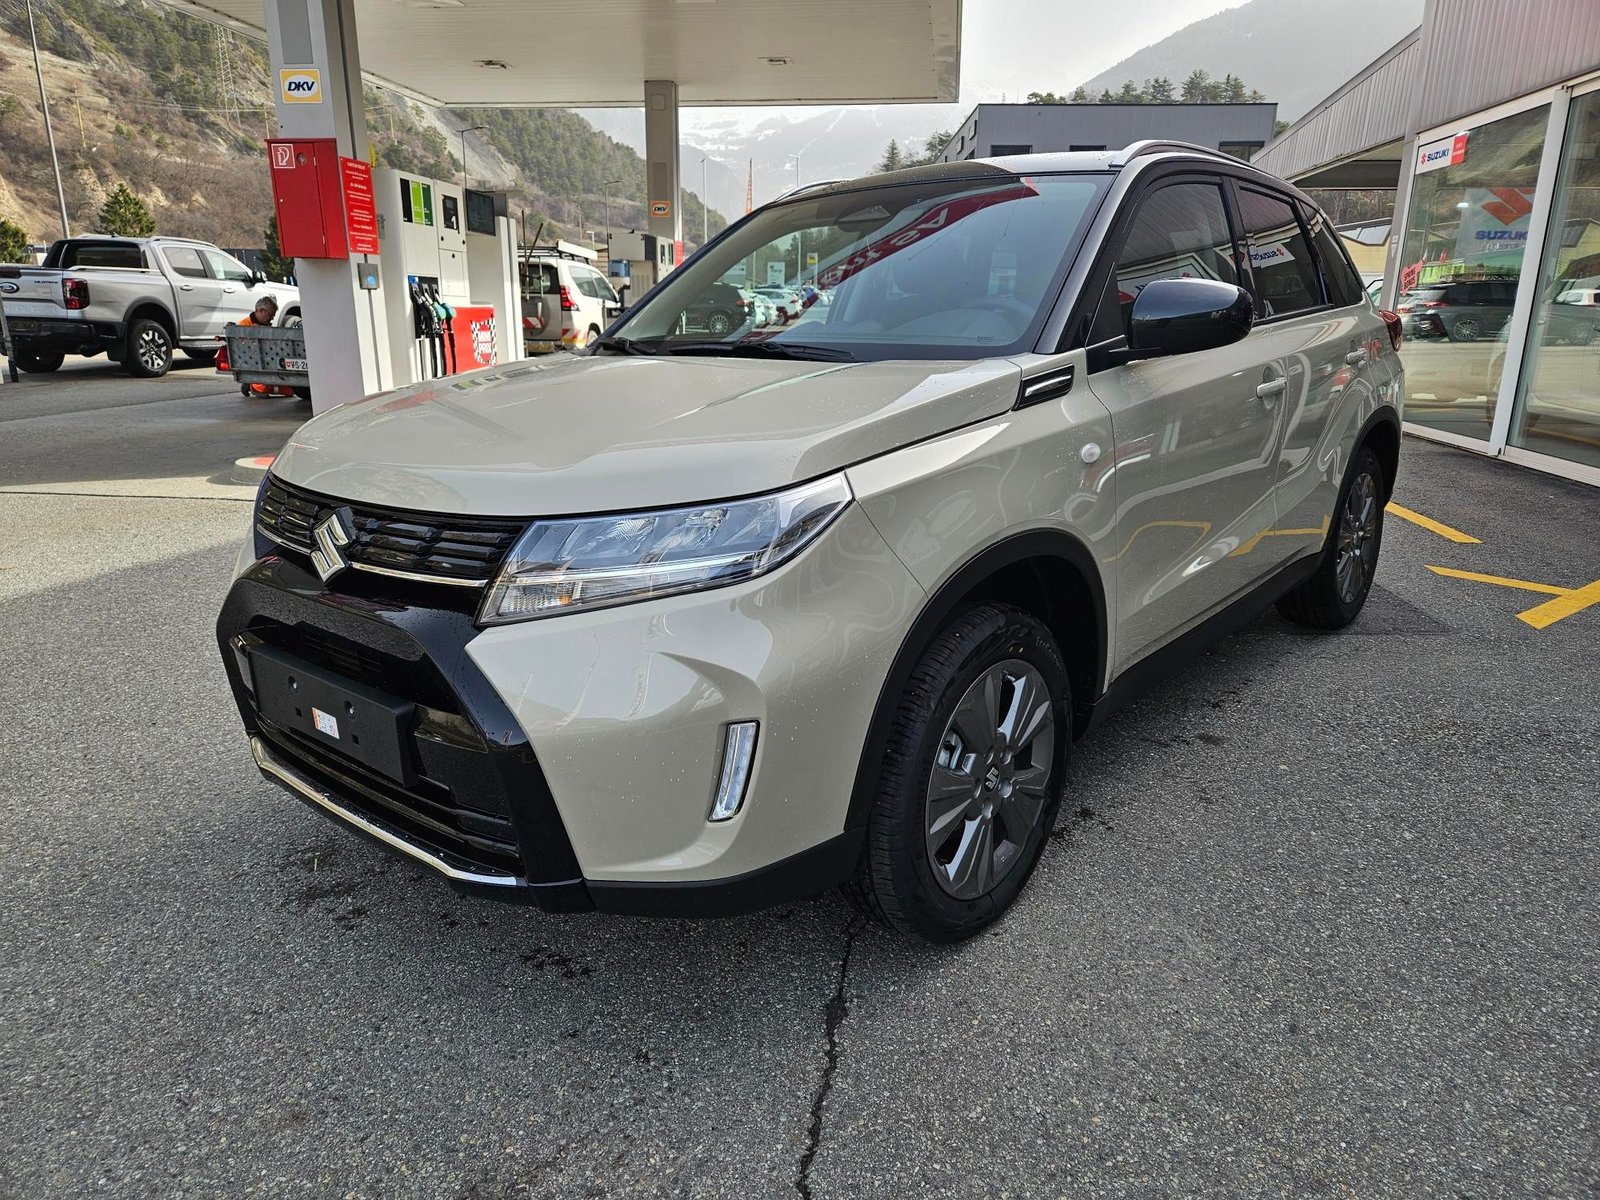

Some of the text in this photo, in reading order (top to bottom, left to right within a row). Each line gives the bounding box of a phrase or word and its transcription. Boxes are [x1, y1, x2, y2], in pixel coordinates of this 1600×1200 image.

[287, 81, 315, 92] DKV
[1427, 149, 1450, 162] SUZUKI
[1475, 230, 1528, 241] SUZUK
